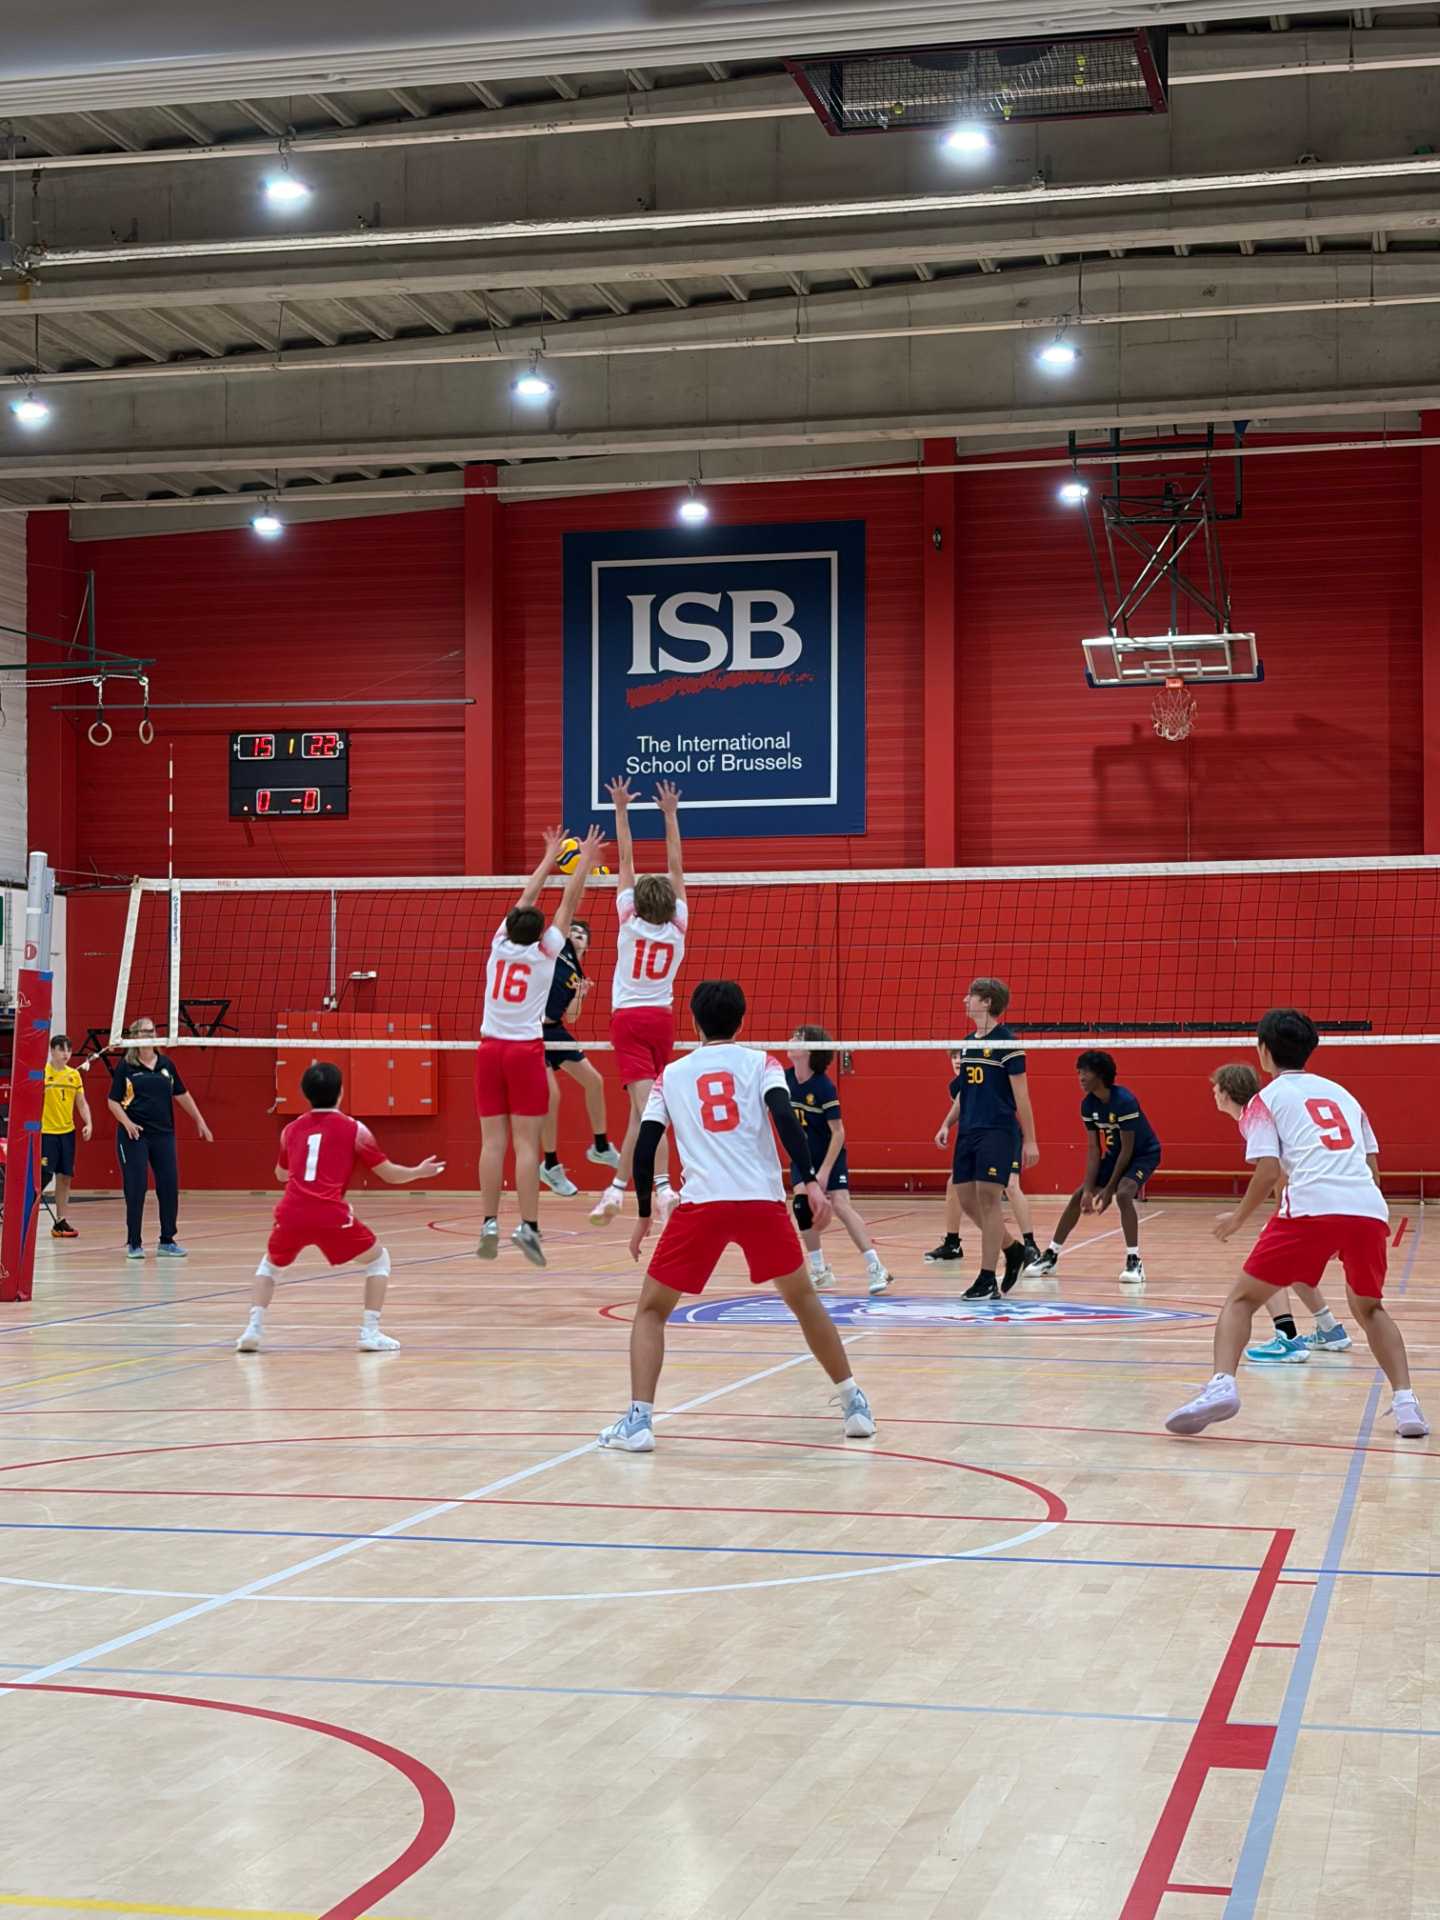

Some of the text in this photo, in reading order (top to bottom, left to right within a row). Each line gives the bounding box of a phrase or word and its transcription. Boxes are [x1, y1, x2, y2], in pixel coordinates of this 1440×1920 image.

[626, 589, 803, 675] ISB
[254, 736, 272, 757] 15
[289, 738, 295, 754] 1
[310, 735, 336, 756] 22
[336, 741, 344, 750] G
[626, 752, 802, 774] School of Brussels
[637, 731, 791, 753] The International
[632, 939, 674, 981] 10
[491, 960, 532, 1003] 16
[61, 1089, 67, 1102] 1
[966, 1066, 984, 1084] 30
[696, 1071, 741, 1134] 8
[1304, 1098, 1355, 1151] 9
[304, 1133, 322, 1182] 1
